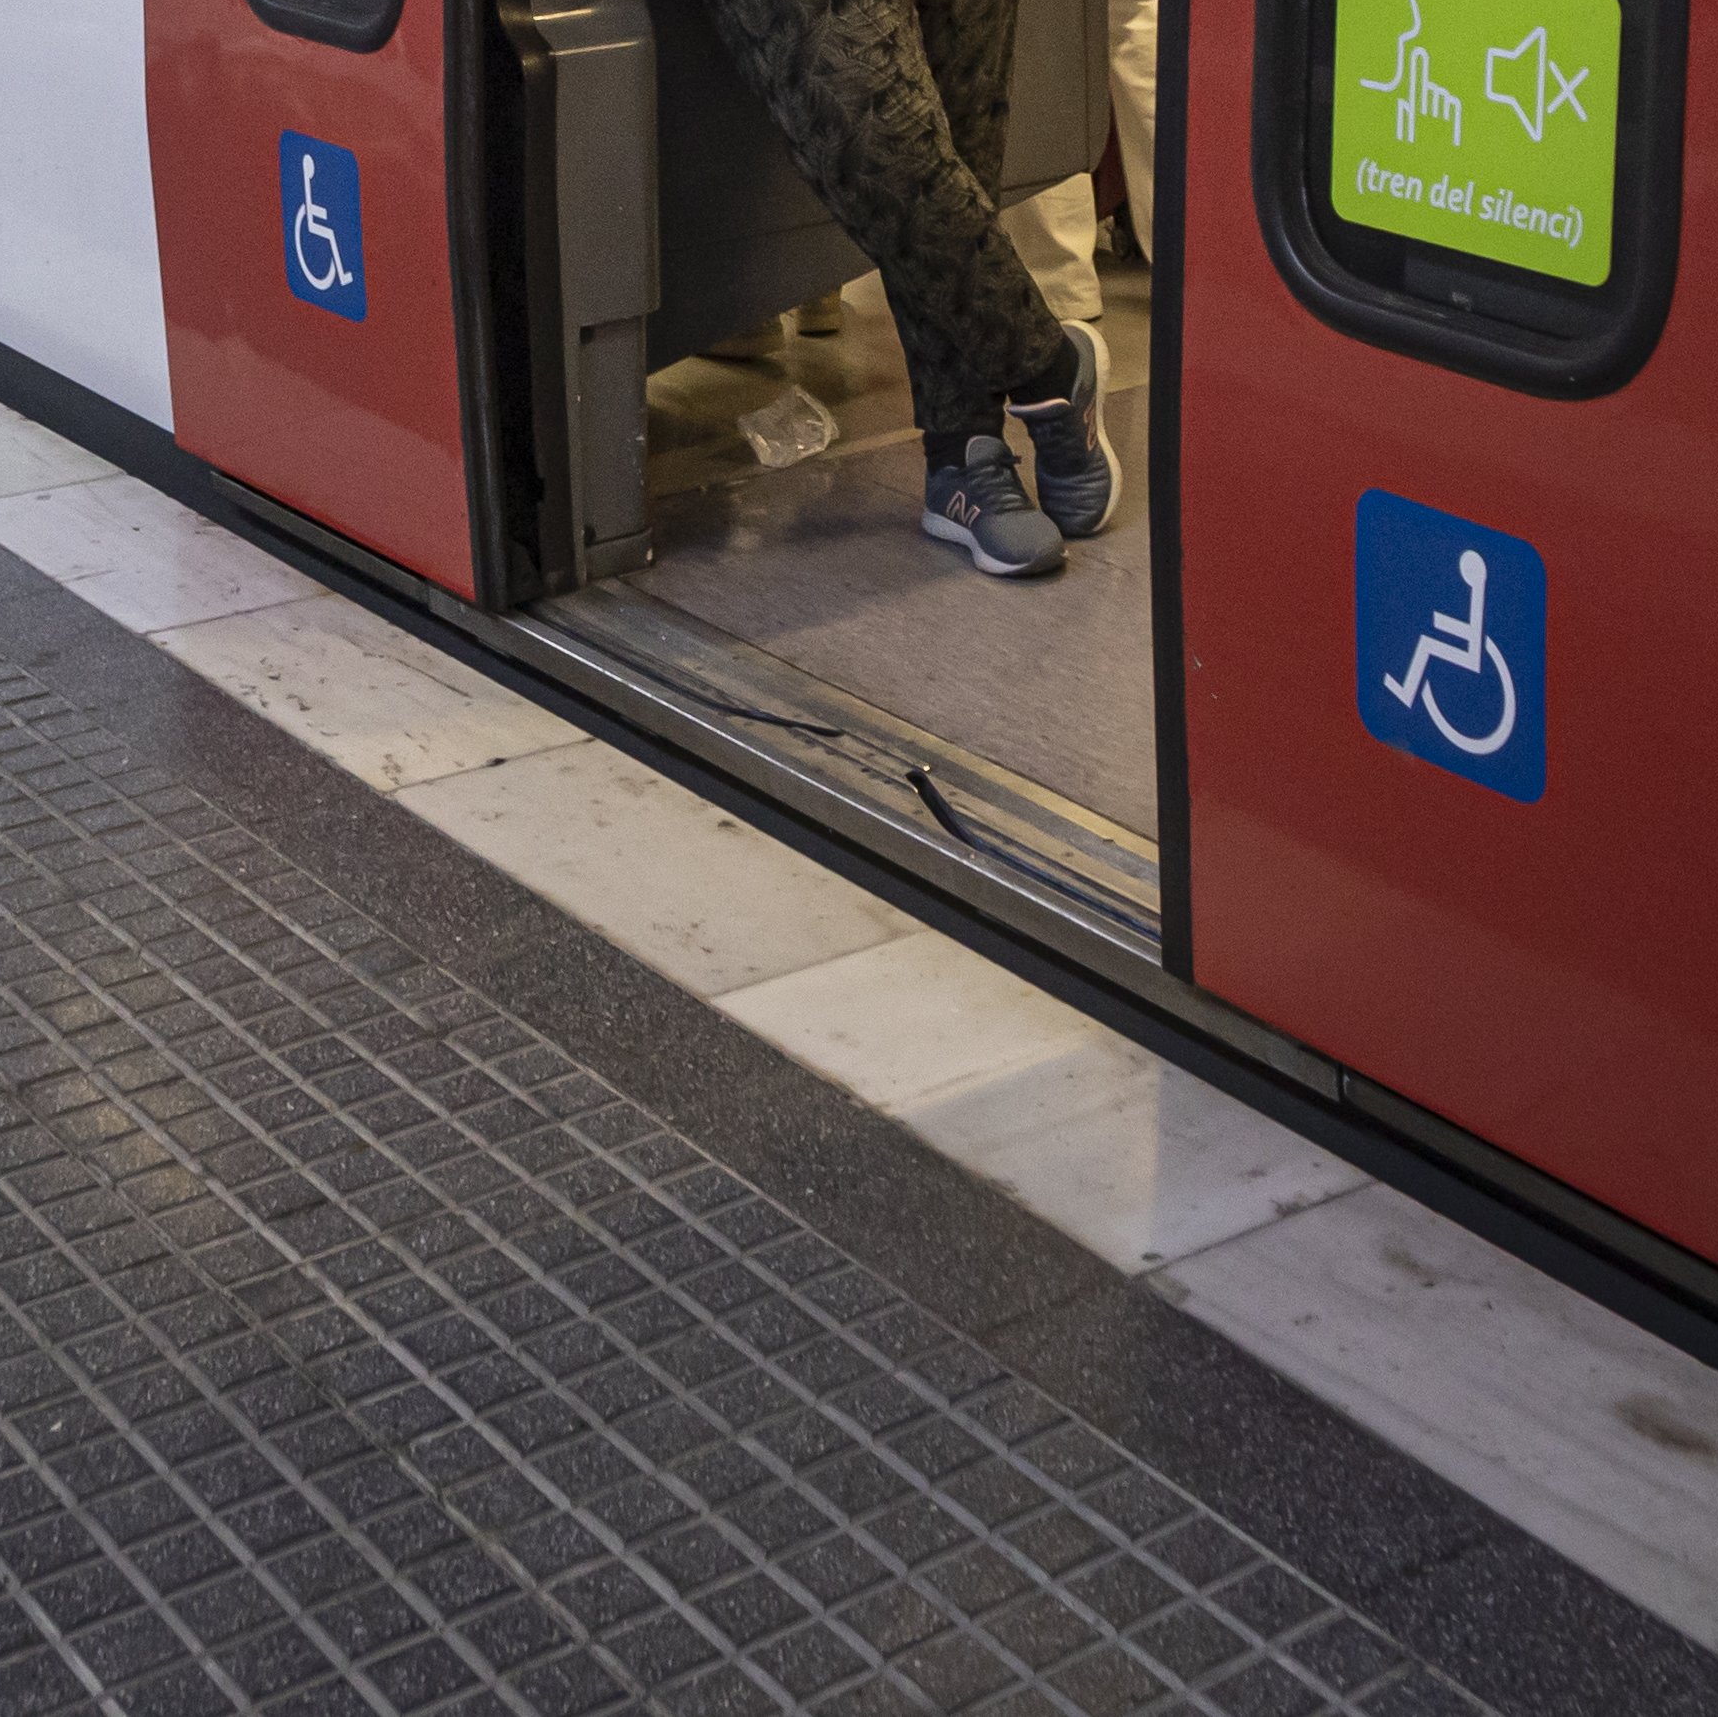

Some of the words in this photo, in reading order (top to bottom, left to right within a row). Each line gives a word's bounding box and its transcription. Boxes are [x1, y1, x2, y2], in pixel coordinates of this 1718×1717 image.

[1356, 157, 1423, 203] (tren
[1428, 174, 1475, 216] del
[1478, 187, 1583, 250] silenci)
